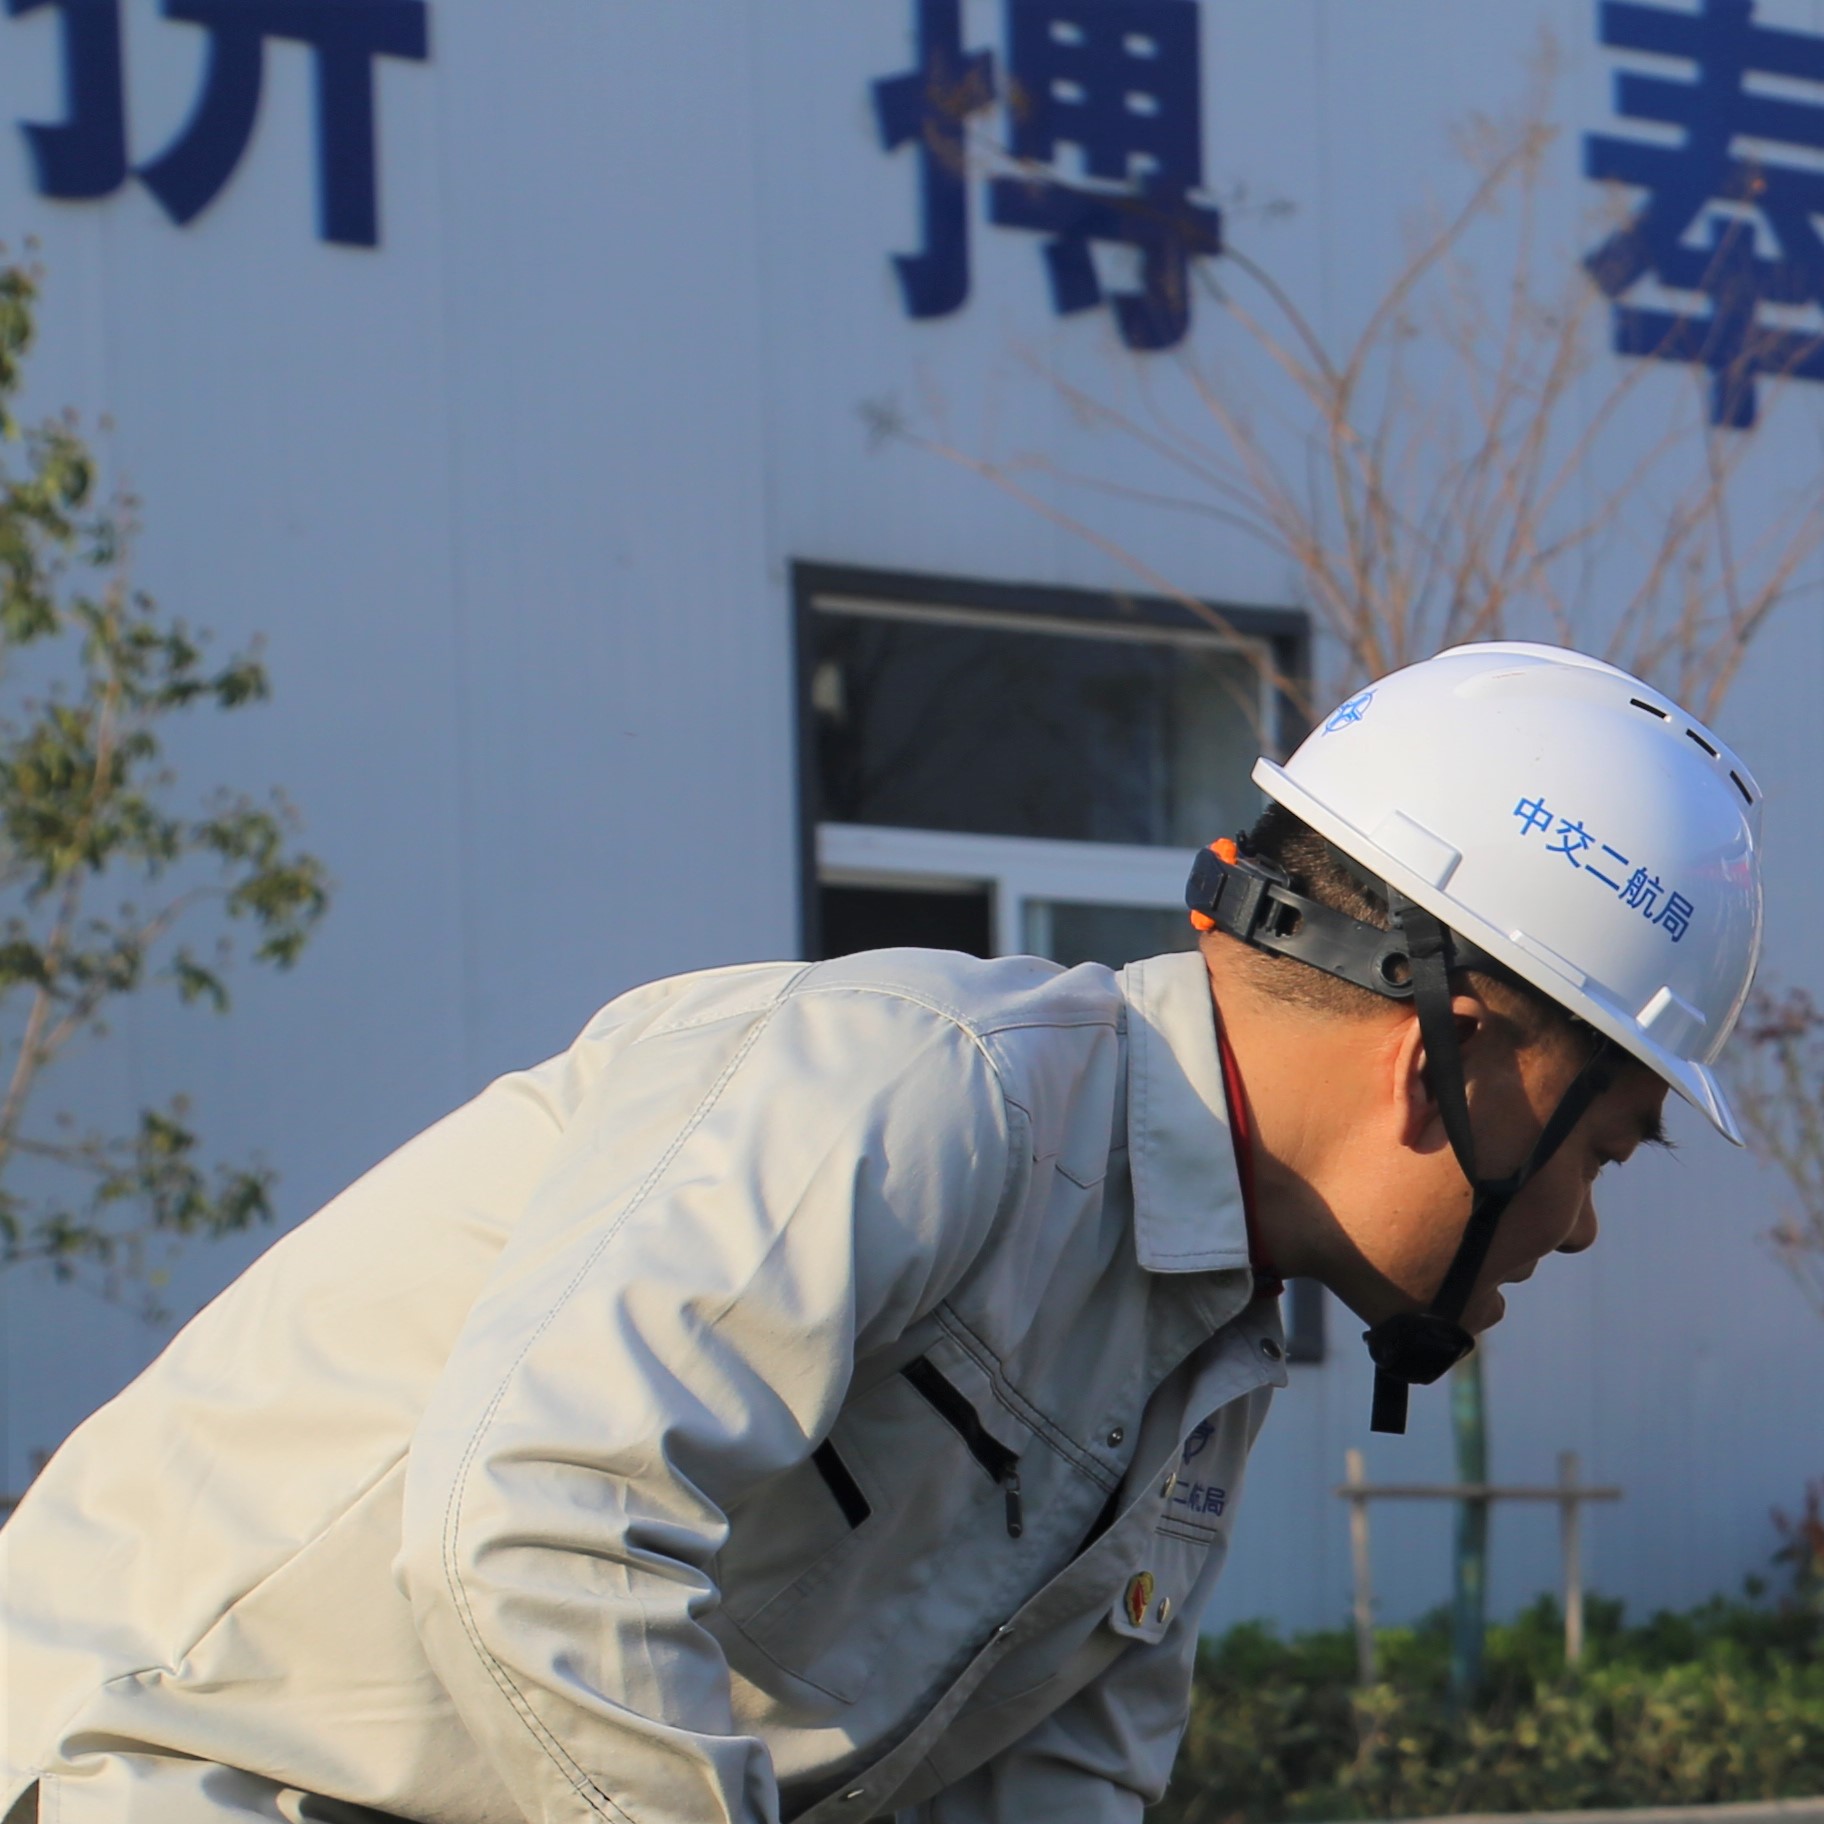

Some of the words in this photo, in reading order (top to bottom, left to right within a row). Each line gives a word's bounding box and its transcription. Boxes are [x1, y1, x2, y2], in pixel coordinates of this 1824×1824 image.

[1512, 797, 1696, 944] 中交二航局
